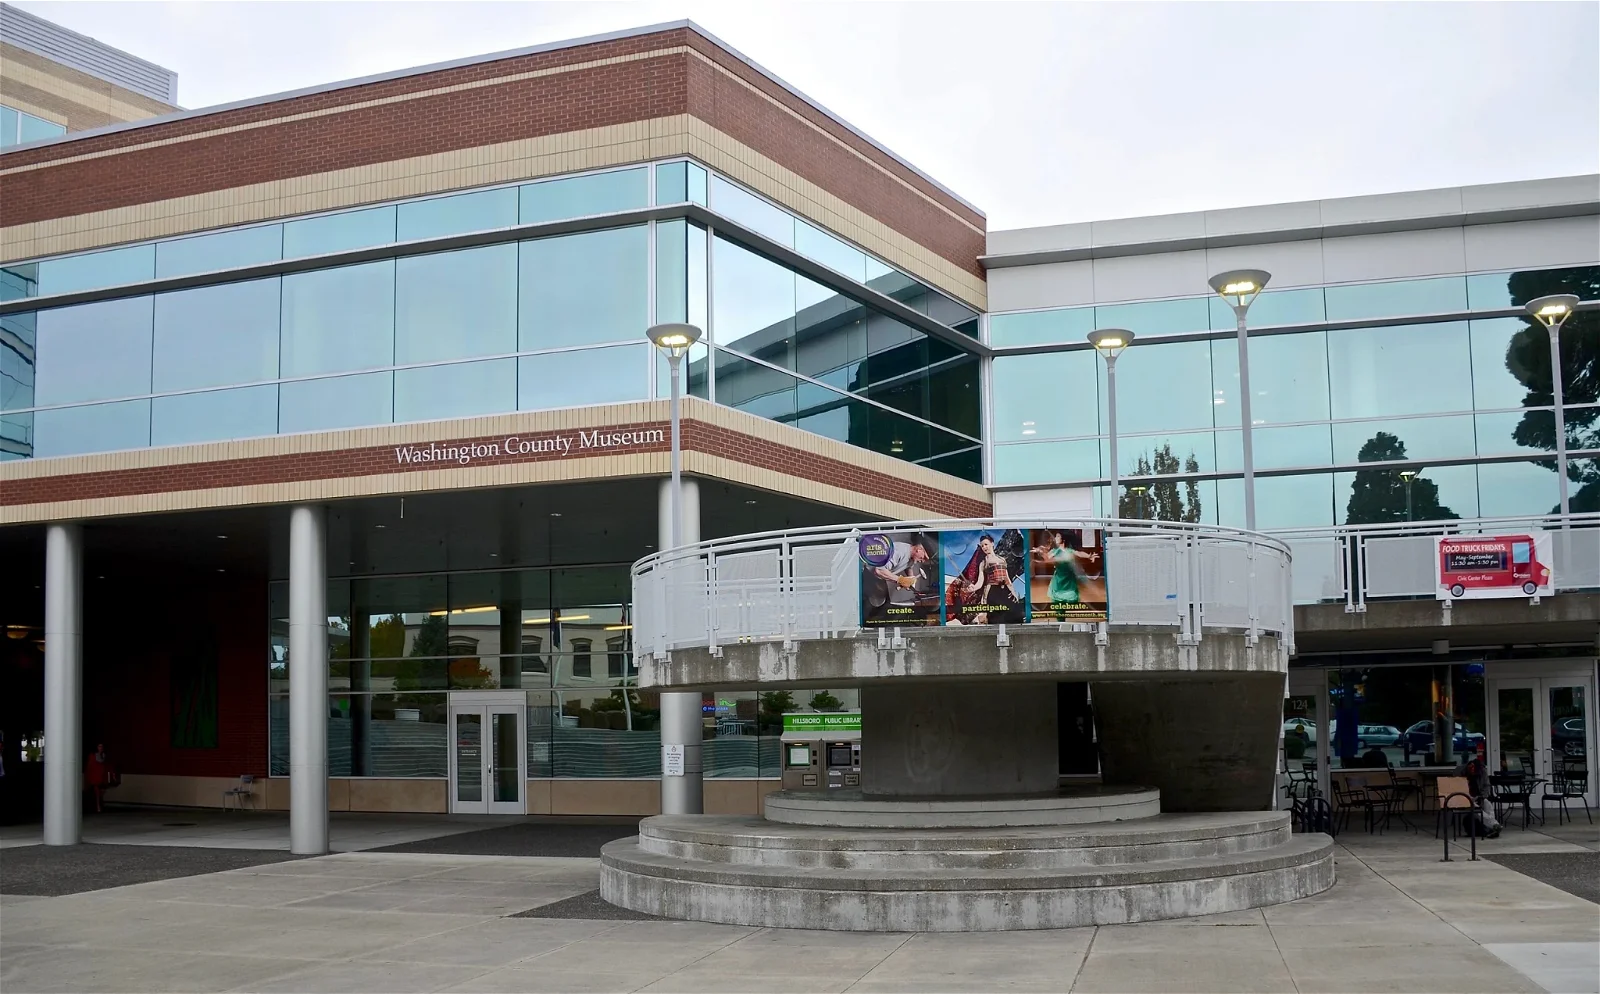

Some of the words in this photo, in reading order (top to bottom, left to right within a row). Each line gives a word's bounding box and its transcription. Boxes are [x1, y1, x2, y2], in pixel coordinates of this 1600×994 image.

[395, 442, 499, 464] Washington
[504, 435, 573, 456] County
[579, 428, 664, 449] Museum
[1442, 545, 1460, 553] FOOD
[1460, 544, 1480, 552] TRUCK
[1481, 543, 1506, 551] FRIDAYS
[962, 604, 1010, 613] participate.
[1050, 602, 1089, 610] celebrate.
[1291, 699, 1308, 710] 124
